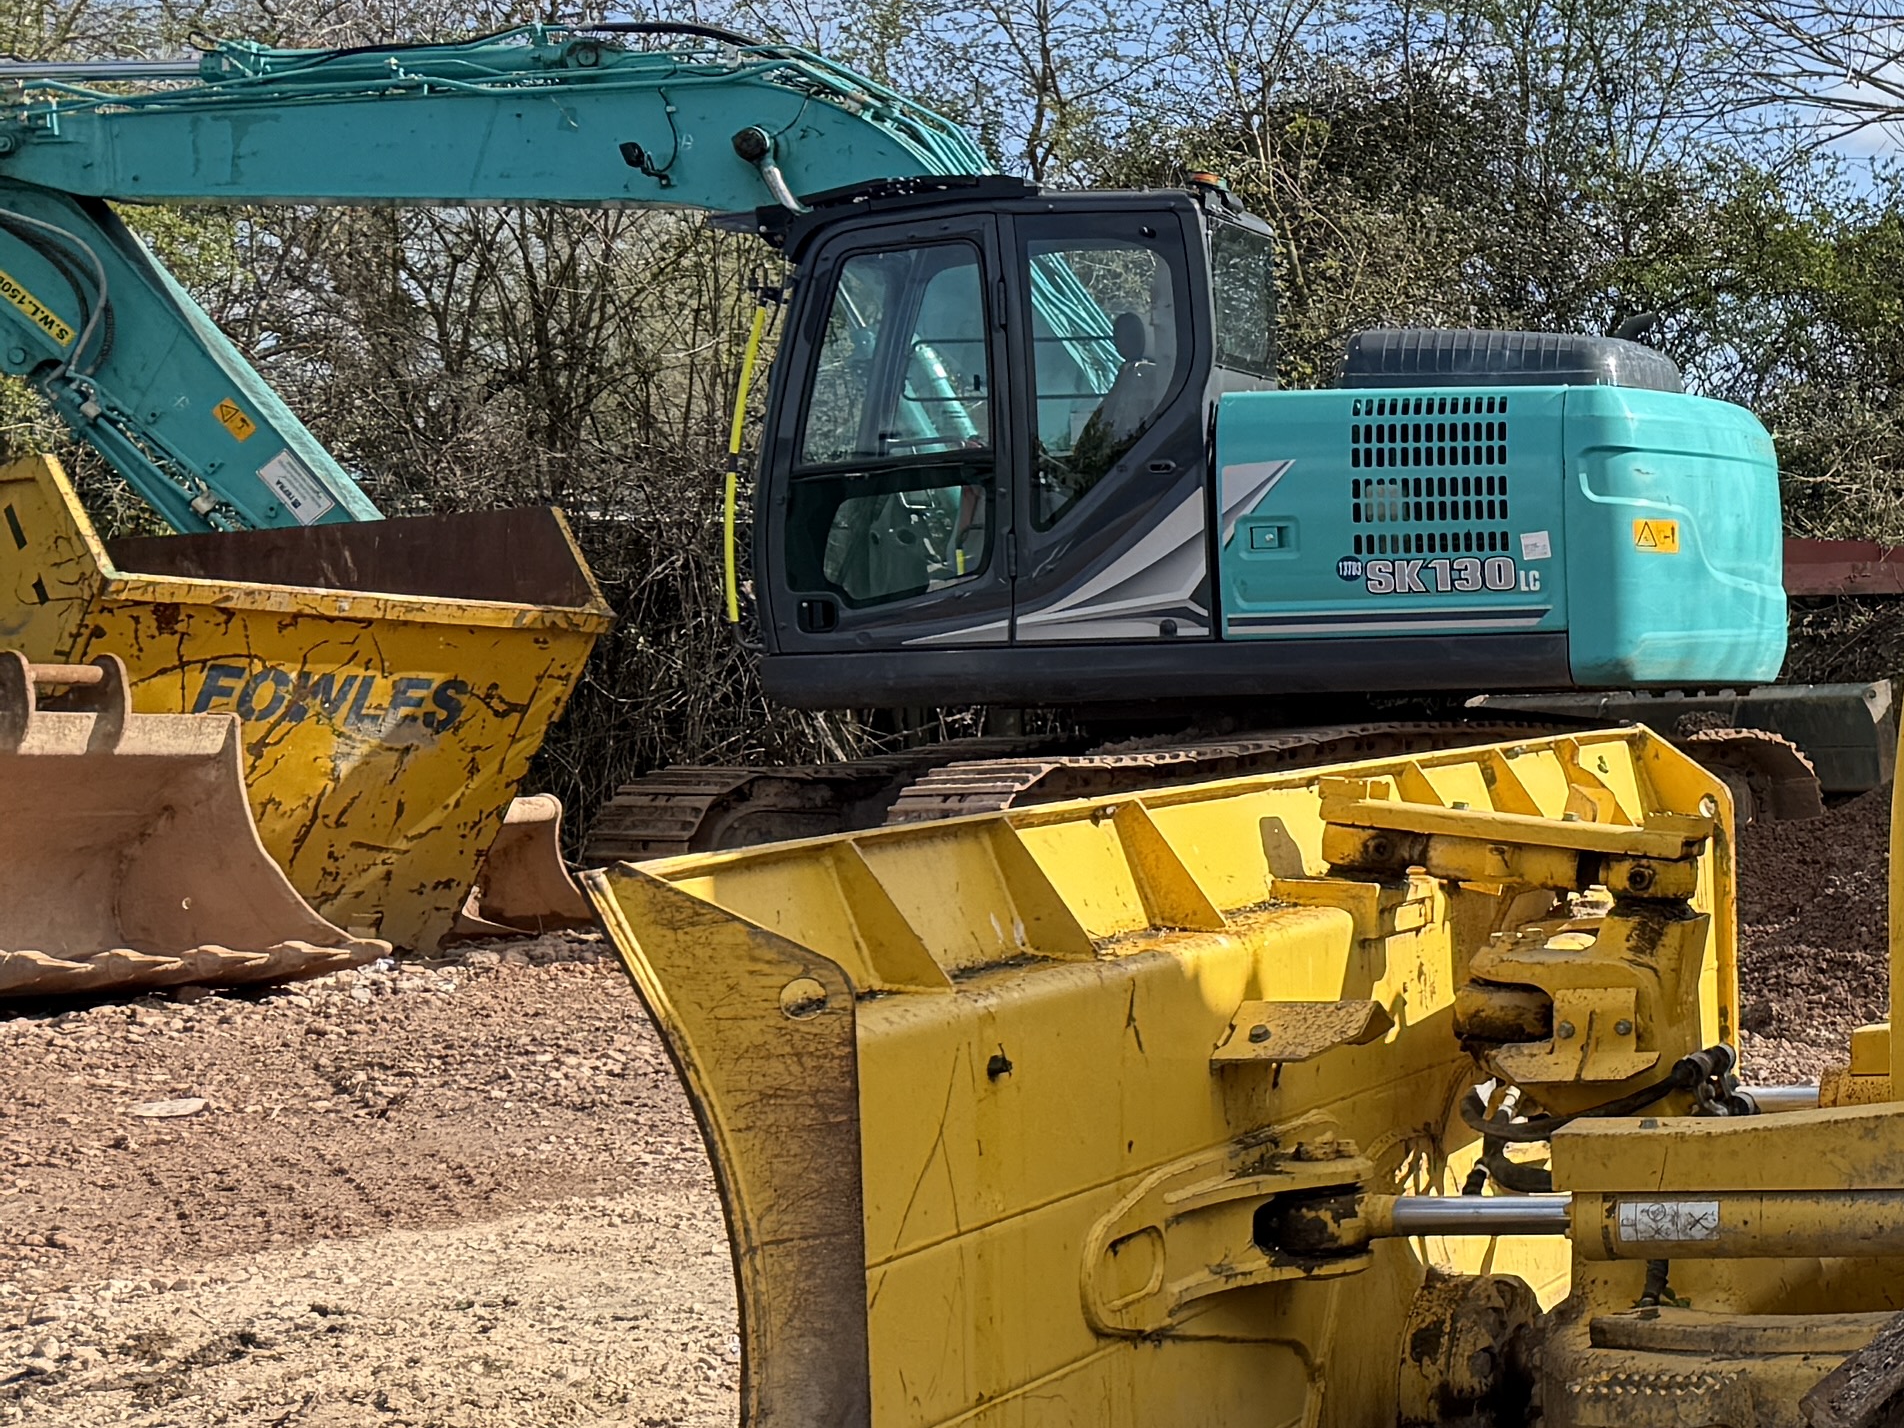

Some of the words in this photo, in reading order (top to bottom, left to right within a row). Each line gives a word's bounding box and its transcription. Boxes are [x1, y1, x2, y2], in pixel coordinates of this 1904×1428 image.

[1366, 556, 1517, 594] SK130
[1519, 570, 1541, 592] LC
[192, 663, 471, 735] FOWLES
